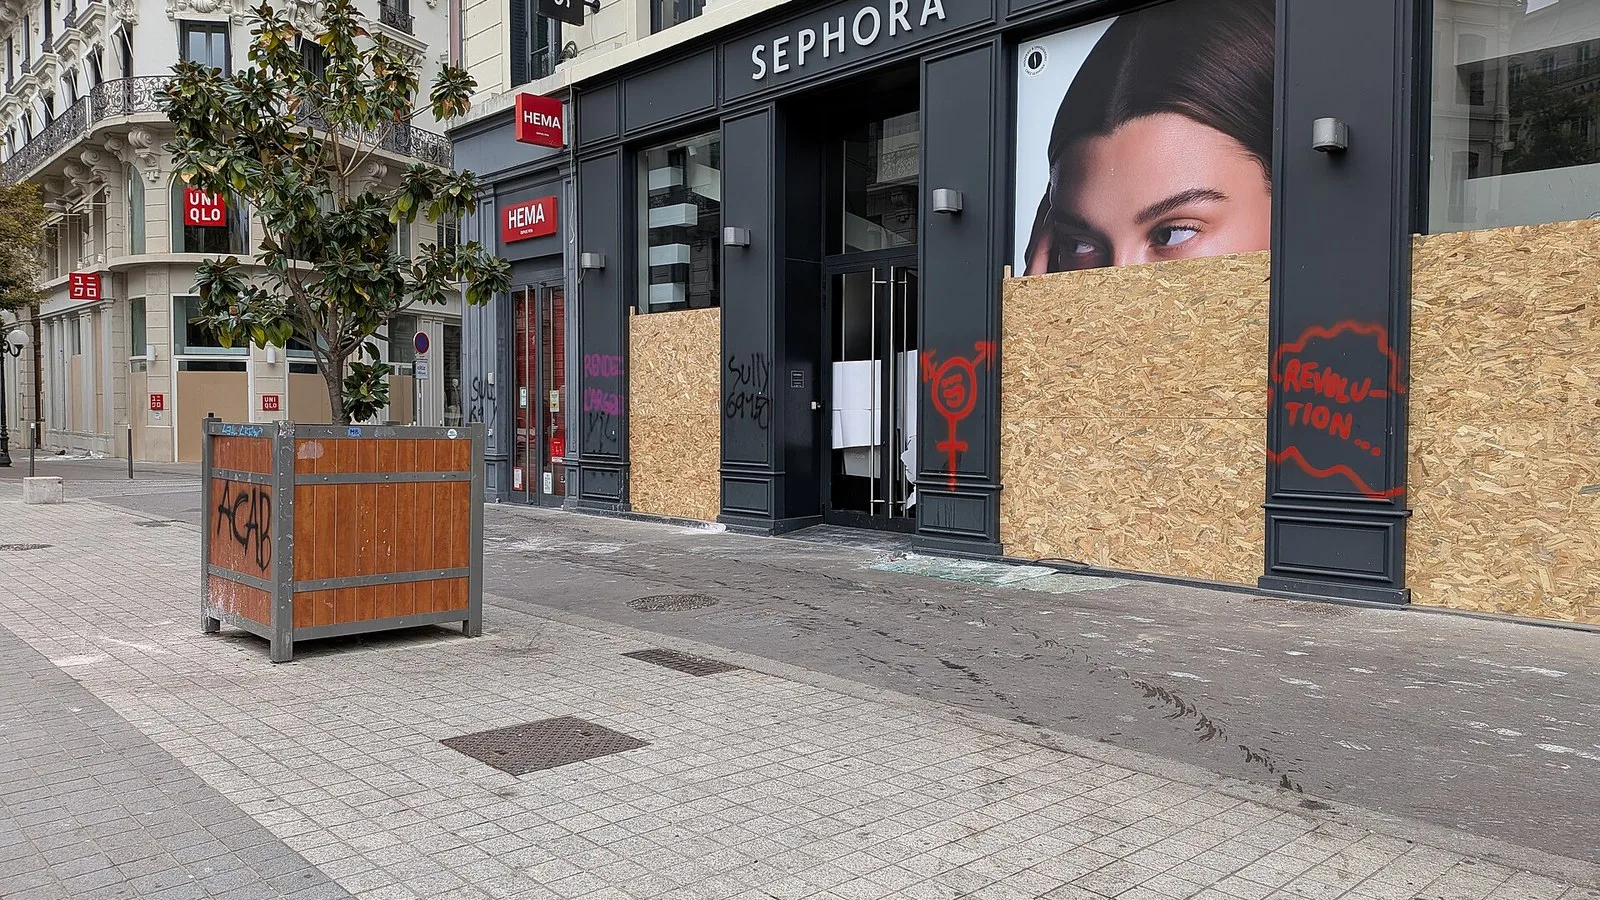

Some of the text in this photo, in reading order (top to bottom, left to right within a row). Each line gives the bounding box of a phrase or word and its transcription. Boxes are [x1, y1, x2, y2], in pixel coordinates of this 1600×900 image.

[751, 0, 946, 80] SEPHORA
[523, 110, 561, 130] HEMA
[190, 192, 218, 206] UNI
[190, 208, 221, 223] QLO
[508, 203, 545, 230] HEMA
[217, 480, 272, 572] ACAB
